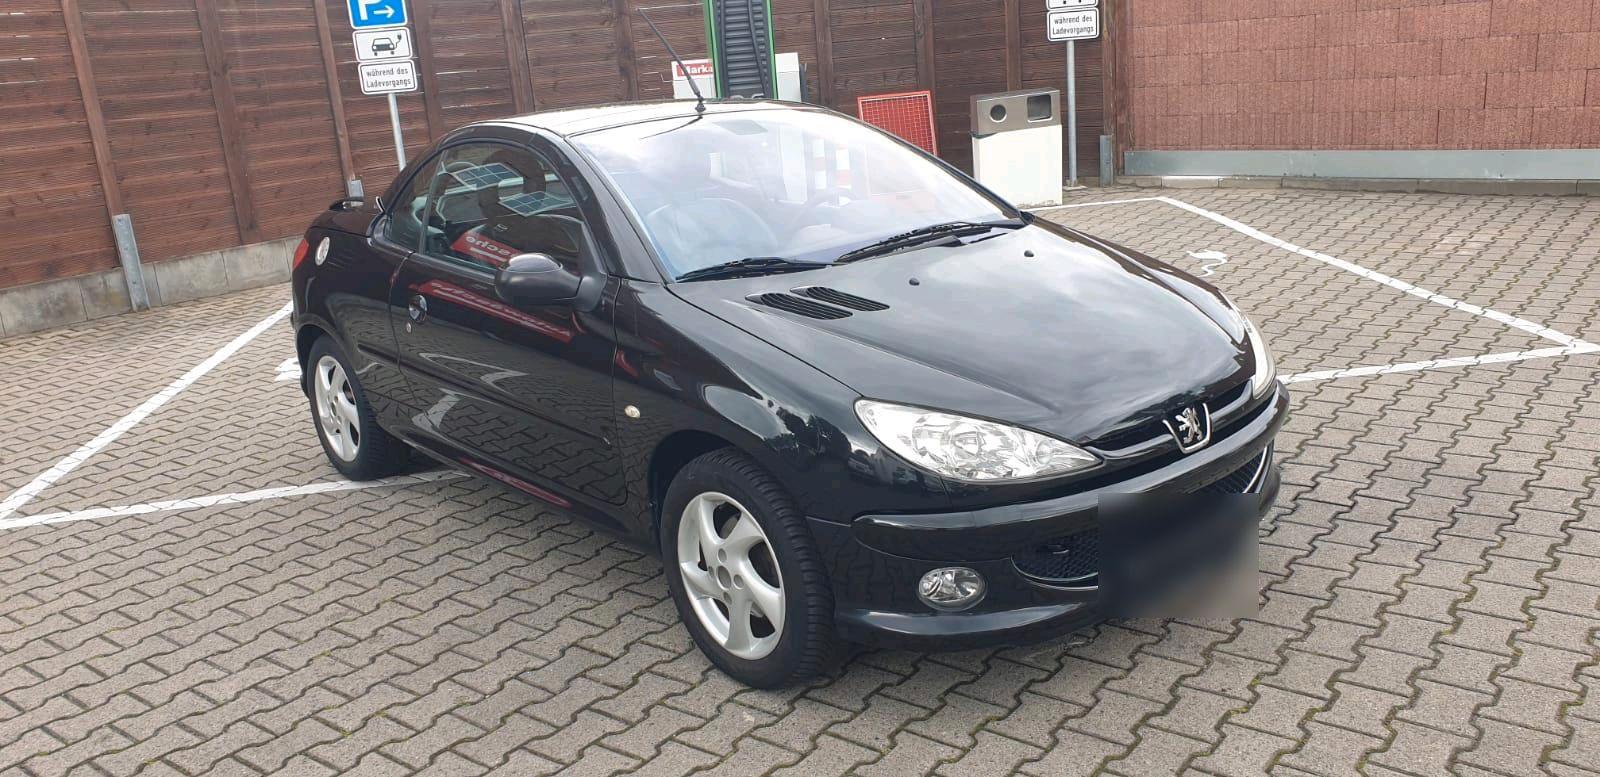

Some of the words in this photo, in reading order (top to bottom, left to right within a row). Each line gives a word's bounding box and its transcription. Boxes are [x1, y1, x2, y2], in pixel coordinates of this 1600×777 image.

[1052, 26, 1094, 35] Ladevorgangs
[366, 68, 394, 77] während
[396, 67, 409, 75] des
[366, 78, 412, 88] Ladevorgangs
